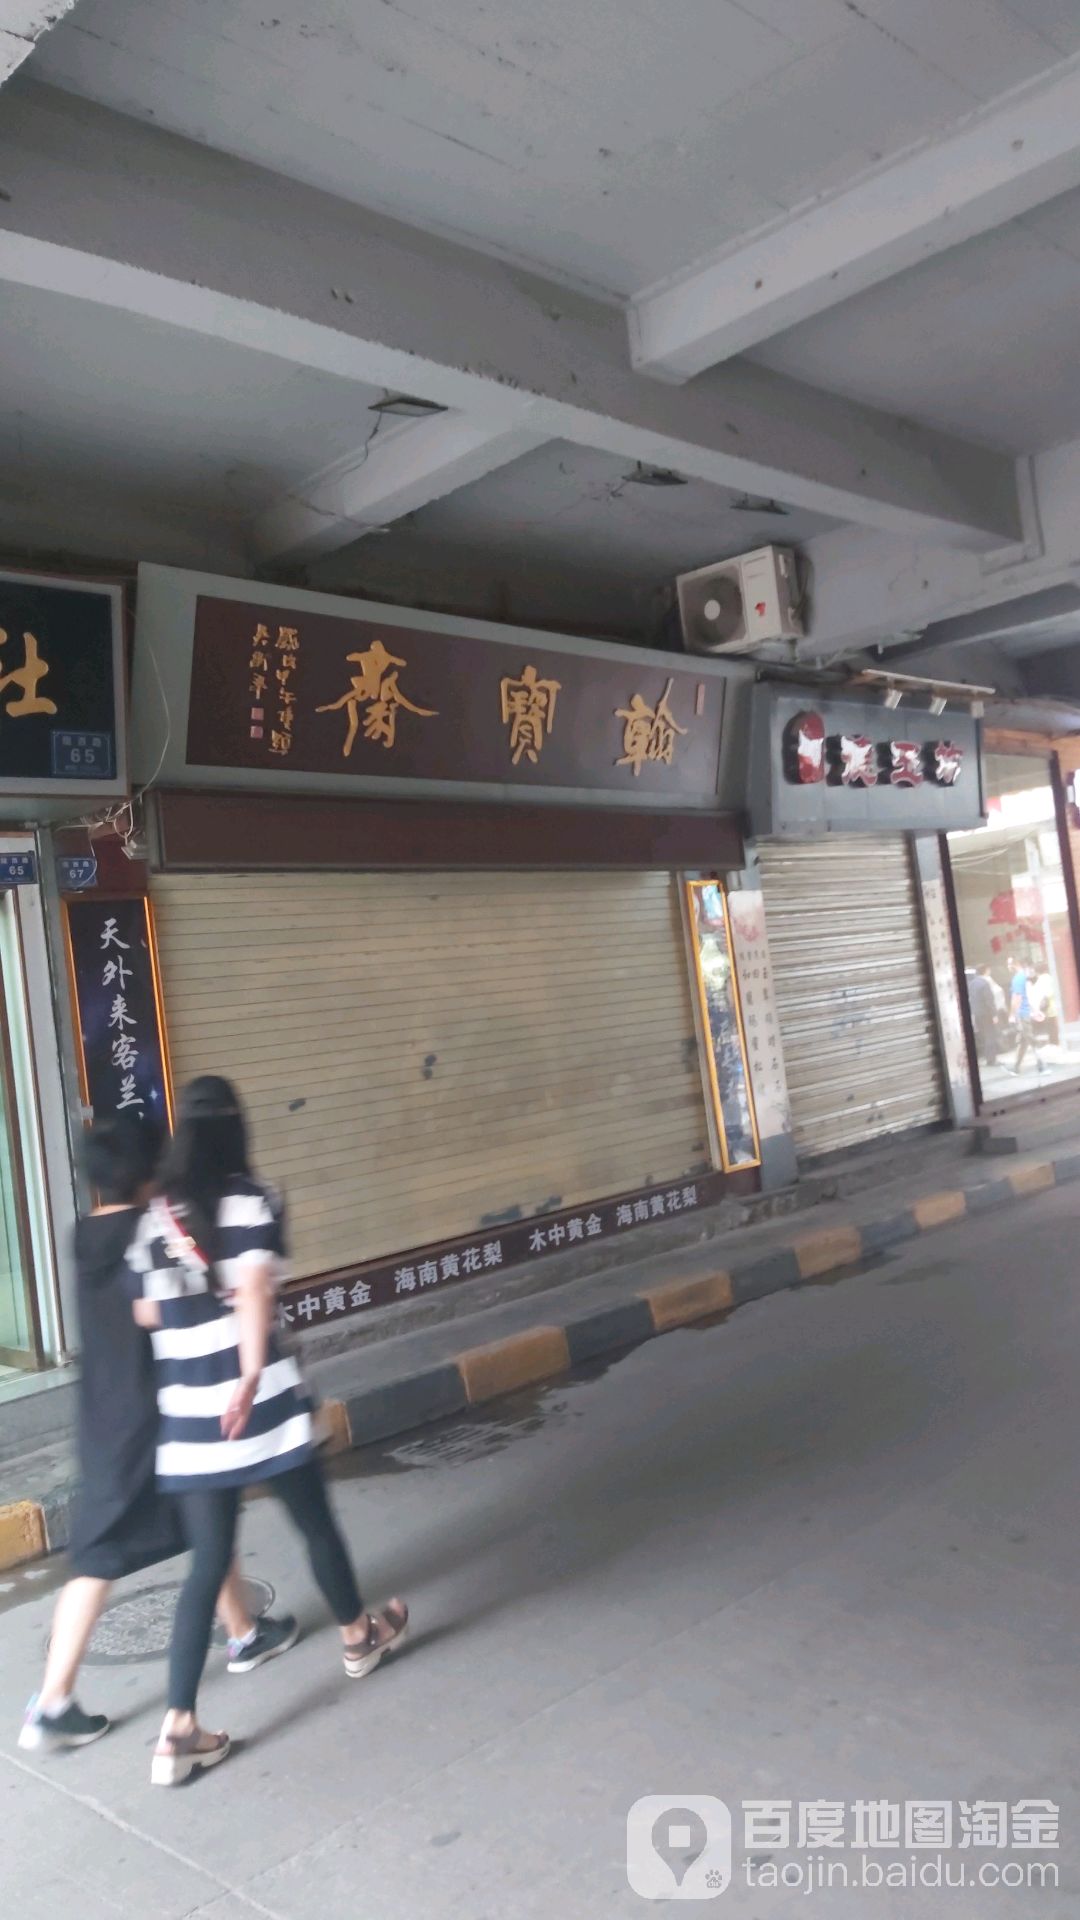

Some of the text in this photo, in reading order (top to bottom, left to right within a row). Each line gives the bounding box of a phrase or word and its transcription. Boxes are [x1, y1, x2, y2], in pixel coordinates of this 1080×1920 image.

[70, 748, 95, 763] 65
[9, 865, 25, 876] 65
[69, 869, 84, 879] 67
[100, 918, 145, 1119] 天外来客兰
[393, 1239, 503, 1294] 海南黄花梨
[529, 1211, 603, 1253] 木中黄金
[615, 1185, 698, 1227] 海南黄花梨
